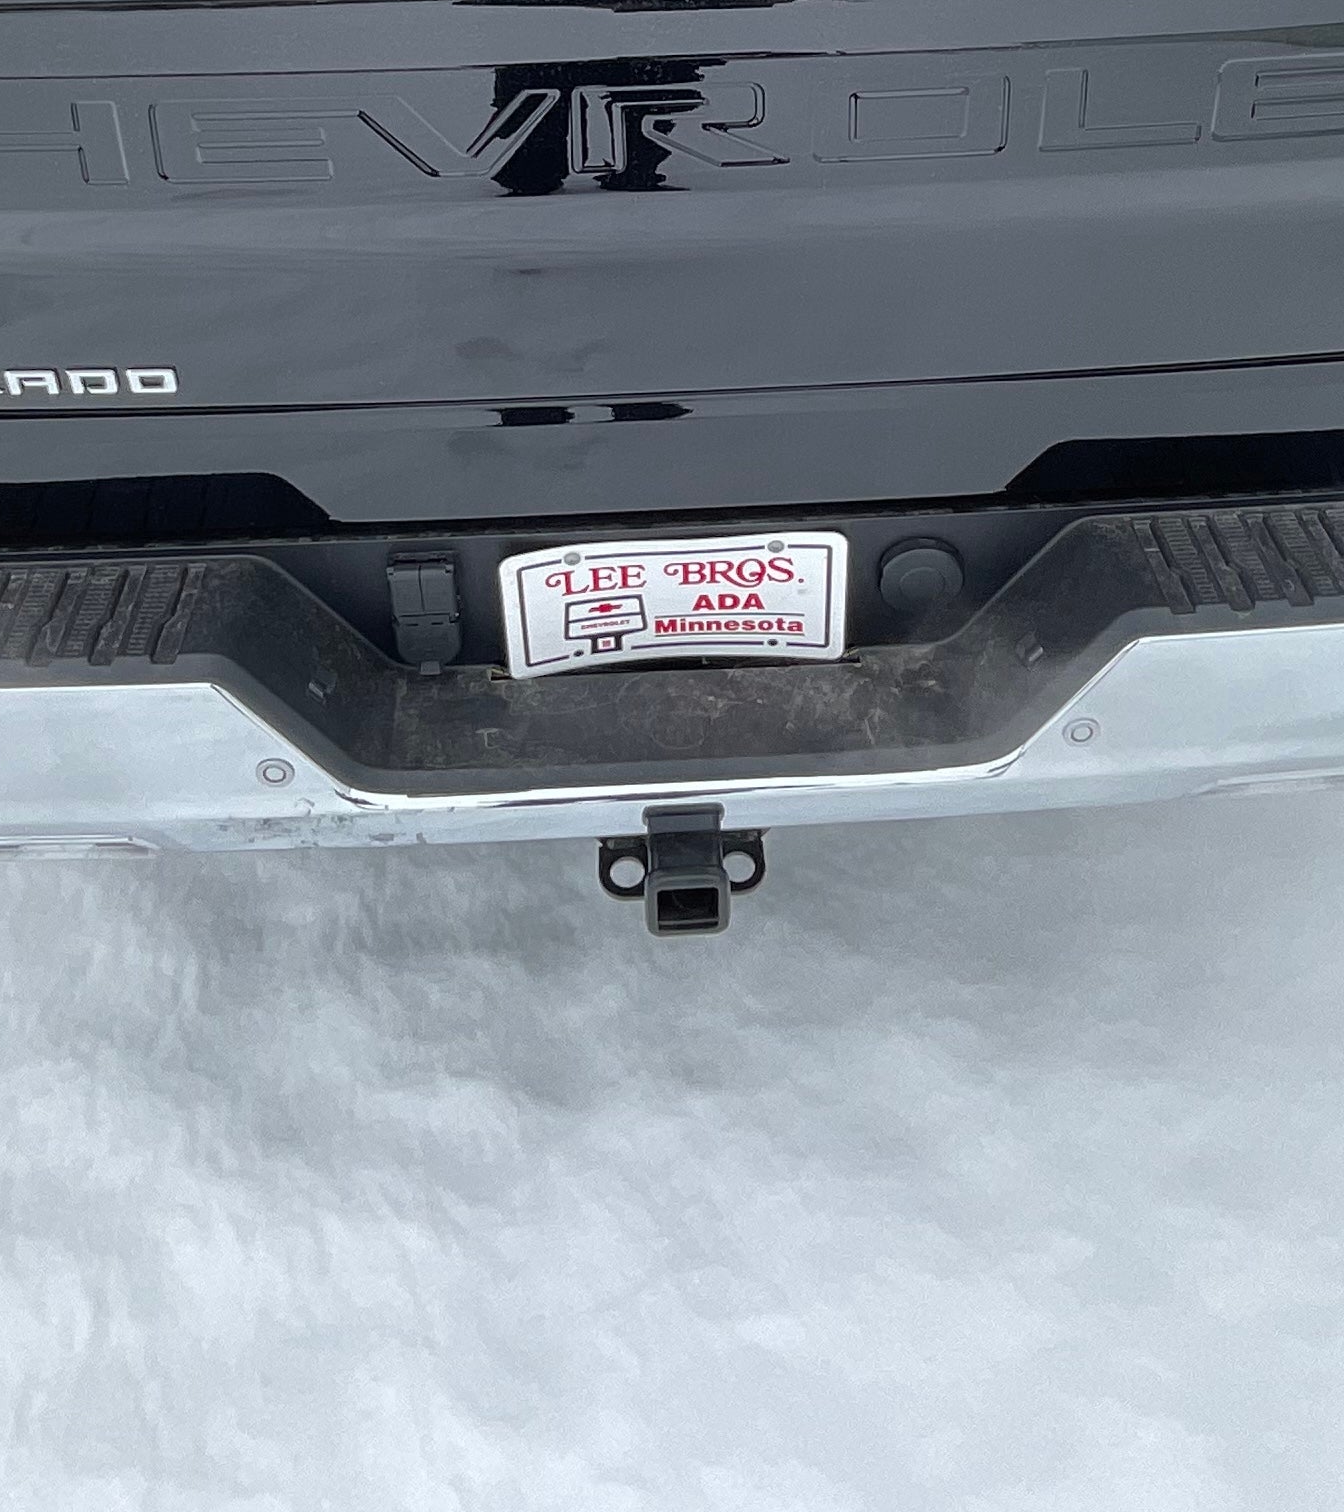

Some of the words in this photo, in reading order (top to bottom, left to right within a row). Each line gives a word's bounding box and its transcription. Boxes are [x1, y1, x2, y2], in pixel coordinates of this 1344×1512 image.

[545, 565, 647, 596] LEE
[663, 557, 805, 587] BROS.
[692, 593, 765, 611] ADA
[654, 617, 803, 634] Minnesota
